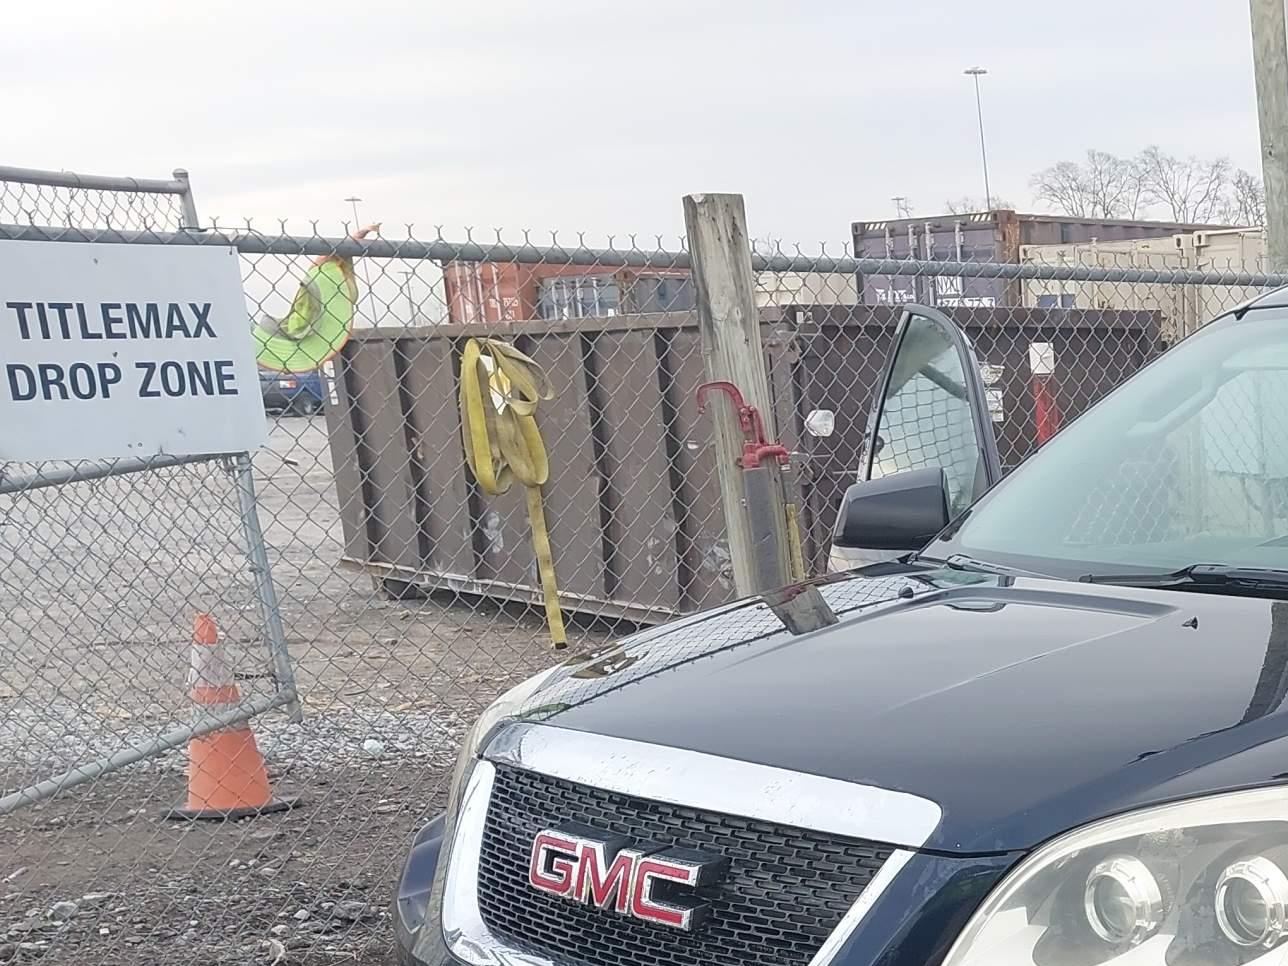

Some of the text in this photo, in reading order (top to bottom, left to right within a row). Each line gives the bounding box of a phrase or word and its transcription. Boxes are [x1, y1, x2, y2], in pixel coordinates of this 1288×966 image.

[6, 301, 218, 341] TITLEMAX
[7, 360, 239, 402] DROP ZONE
[529, 828, 699, 931] GMC
